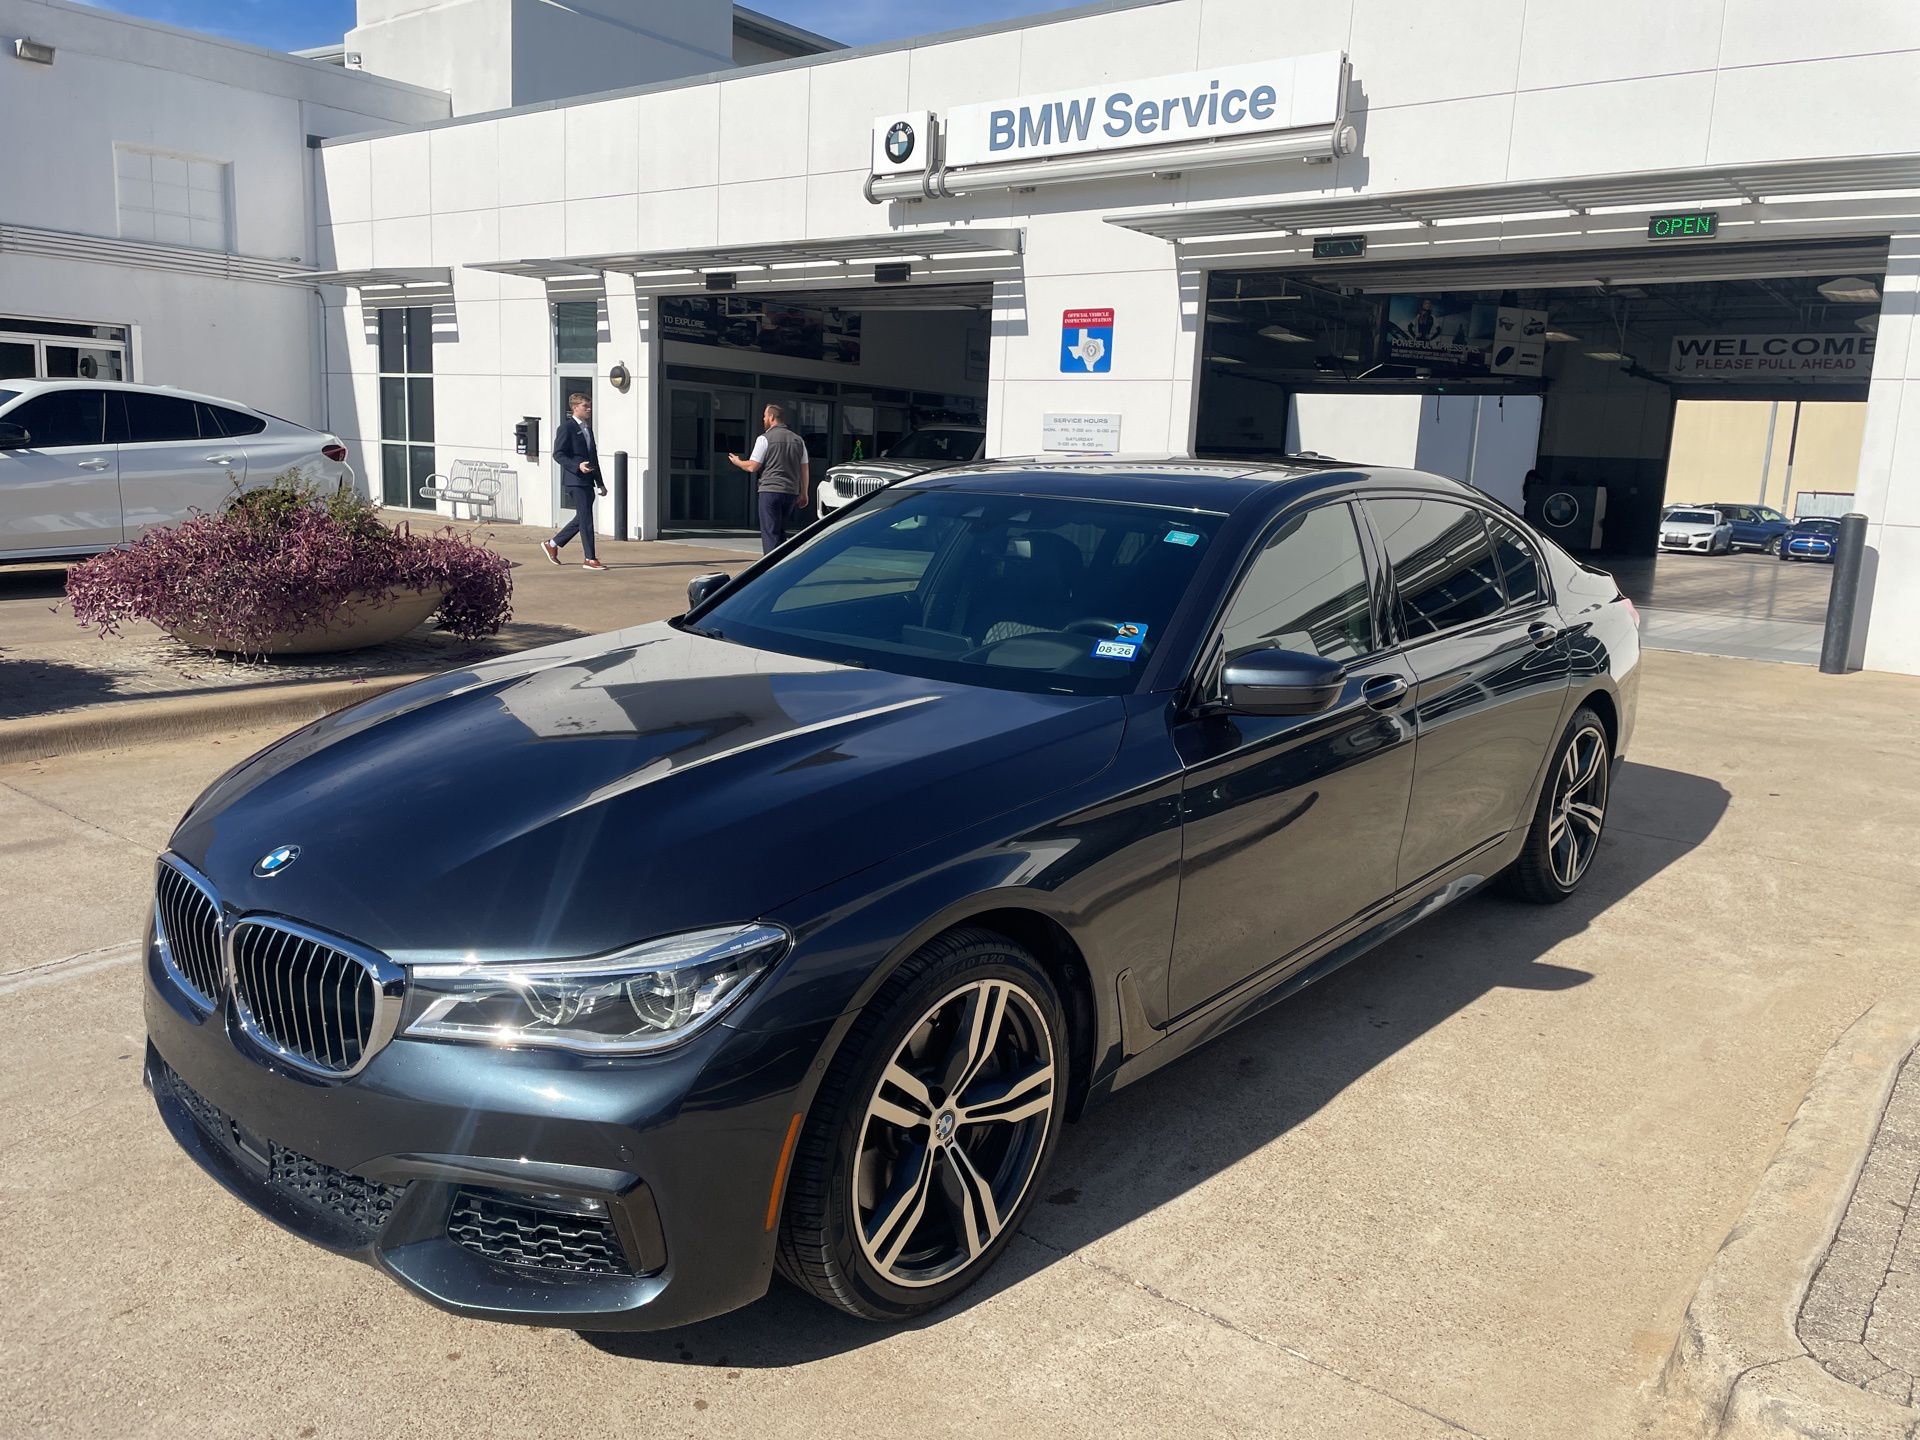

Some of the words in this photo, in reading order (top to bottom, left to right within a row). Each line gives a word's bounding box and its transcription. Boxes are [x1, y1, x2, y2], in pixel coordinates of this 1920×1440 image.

[989, 97, 1096, 151] BMW
[1103, 80, 1277, 138] Service
[1655, 216, 1711, 236] OPEN
[664, 315, 673, 324] TO
[1392, 338, 1431, 349] POWERFUL
[1676, 338, 1876, 356] WELCOME
[1695, 359, 1753, 369] PLEASE
[1758, 358, 1796, 369] PULL
[1801, 358, 1856, 369] AHEAD
